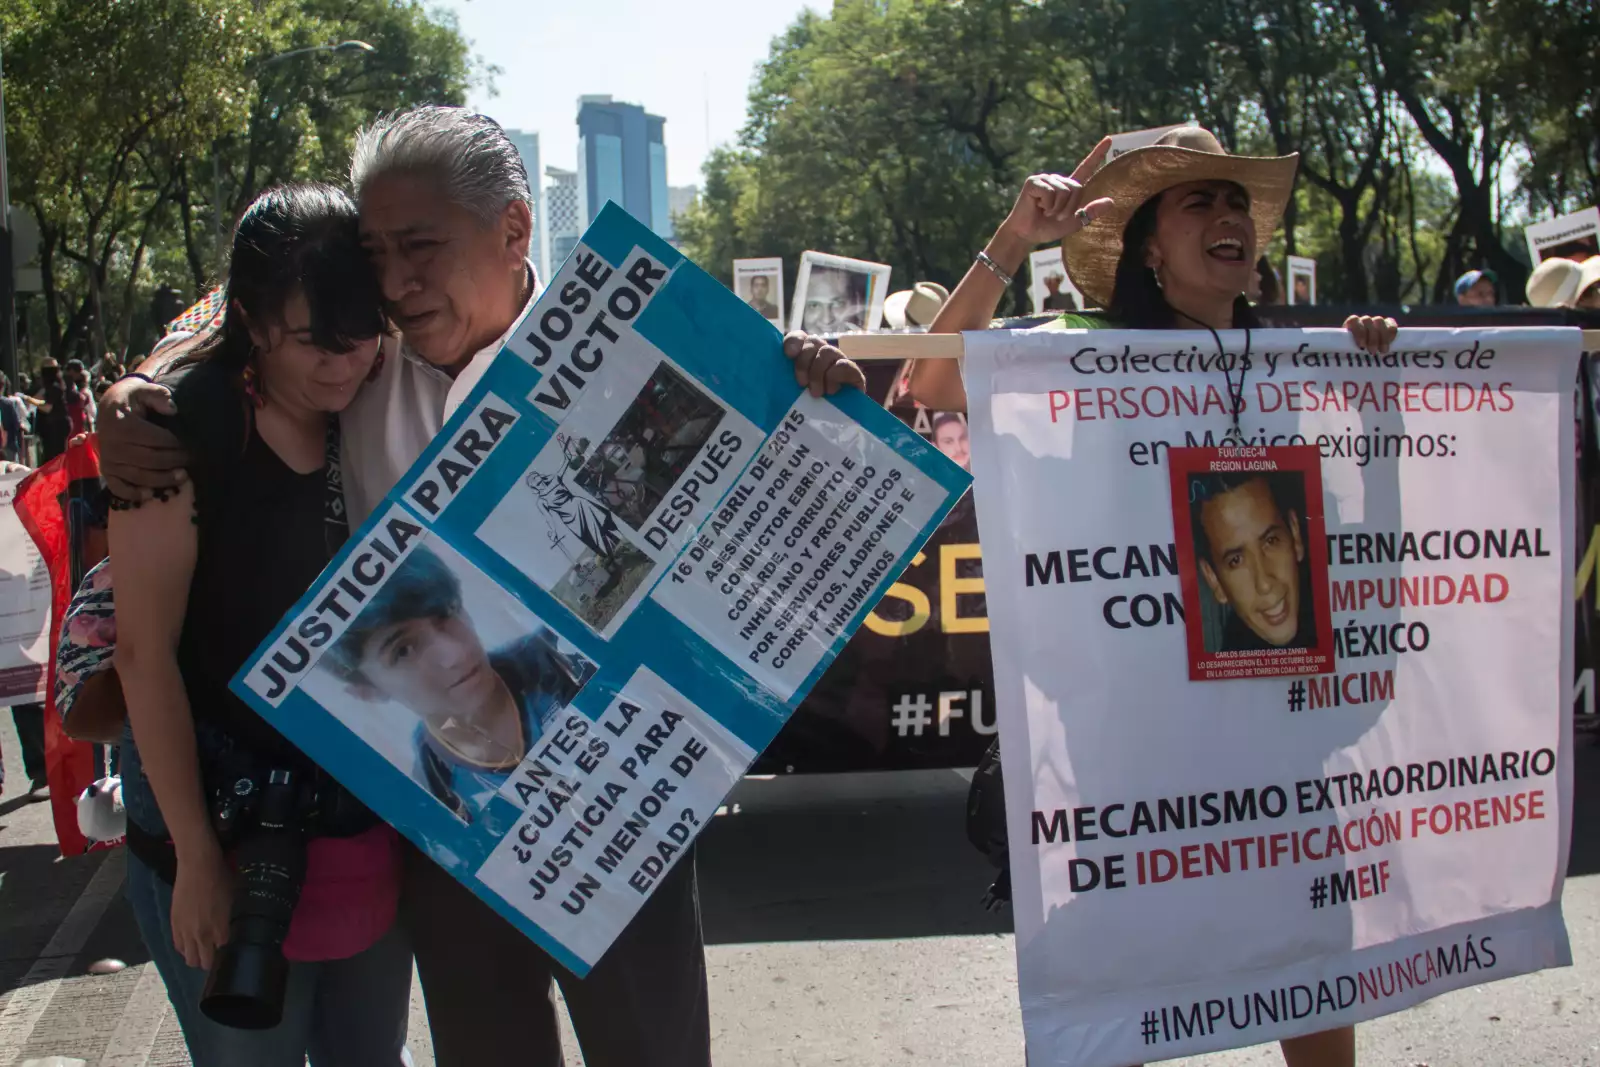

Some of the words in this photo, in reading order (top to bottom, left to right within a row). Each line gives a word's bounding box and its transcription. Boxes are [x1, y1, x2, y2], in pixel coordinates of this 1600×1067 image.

[526, 252, 613, 366] JOSÉ
[534, 257, 666, 410] VICTOR
[1070, 345, 1253, 374] Colectivos
[1265, 352, 1282, 377] y
[1454, 341, 1495, 369] de
[1049, 383, 1247, 422] PERSONAS
[1256, 381, 1514, 413] DESAPARECIDAS
[1129, 440, 1170, 465] en
[1315, 426, 1456, 467] exigimos:
[643, 430, 742, 551] DESPUÉS
[672, 562, 692, 584] 16
[689, 534, 714, 562] DE
[711, 485, 755, 536] ABRIL
[749, 454, 774, 481] DE
[768, 409, 805, 456] 2015
[705, 500, 769, 583] ASESINADO
[765, 468, 793, 500] POR
[788, 444, 810, 468] UN
[1210, 461, 1241, 471] REGION
[1243, 460, 1278, 471] LAGUNA
[261, 518, 422, 699] JUSTICIA
[411, 407, 516, 515] PARA
[721, 506, 793, 595] CONDUCTOR
[787, 461, 830, 507] EBRIO,
[727, 552, 789, 621] COBARDE,
[784, 471, 844, 548] CORRUPTO
[841, 457, 856, 471] E
[739, 561, 804, 640] INHUMANO
[800, 547, 813, 559] Y
[810, 466, 876, 548] PROTEGIDO
[749, 631, 778, 663] POR
[774, 541, 846, 631] SERVIDORES
[842, 469, 901, 542] PUBLICOS
[772, 582, 848, 669] CORRUPTOS,
[841, 502, 904, 579] LADRONES
[900, 488, 914, 502] E
[1025, 543, 1179, 587] MECAN
[1326, 528, 1550, 566] TERNACIONAL
[825, 550, 895, 636] INHUMANOS
[1102, 592, 1187, 629] CON
[1332, 573, 1509, 612] MPUNIDAD
[1215, 650, 1238, 659] CARLOS
[1239, 648, 1266, 658] GERARDO
[1288, 670, 1395, 712] #MICIM
[515, 716, 589, 806] ANTES
[891, 690, 998, 737] #FU
[512, 780, 582, 864] ¿CUÁL
[574, 738, 609, 775] ES
[604, 702, 641, 737] LA
[529, 782, 628, 900] JUSTICIA
[619, 710, 684, 780] PARA
[561, 873, 601, 915] UN
[595, 778, 678, 874] MENOR
[670, 737, 707, 778] DE
[1030, 784, 1287, 845] MECANISMO
[1296, 747, 1556, 814] EXTRAORDINARIO
[628, 808, 700, 895] EDAD?
[1068, 854, 1126, 894] DE
[1136, 809, 1402, 885] IDENTIFICACIÓN
[1410, 790, 1545, 839] FORENSE
[1309, 860, 1391, 909] #MEIF
[1140, 935, 1497, 1045] #IMPUNIDADNUNCAMÁS
